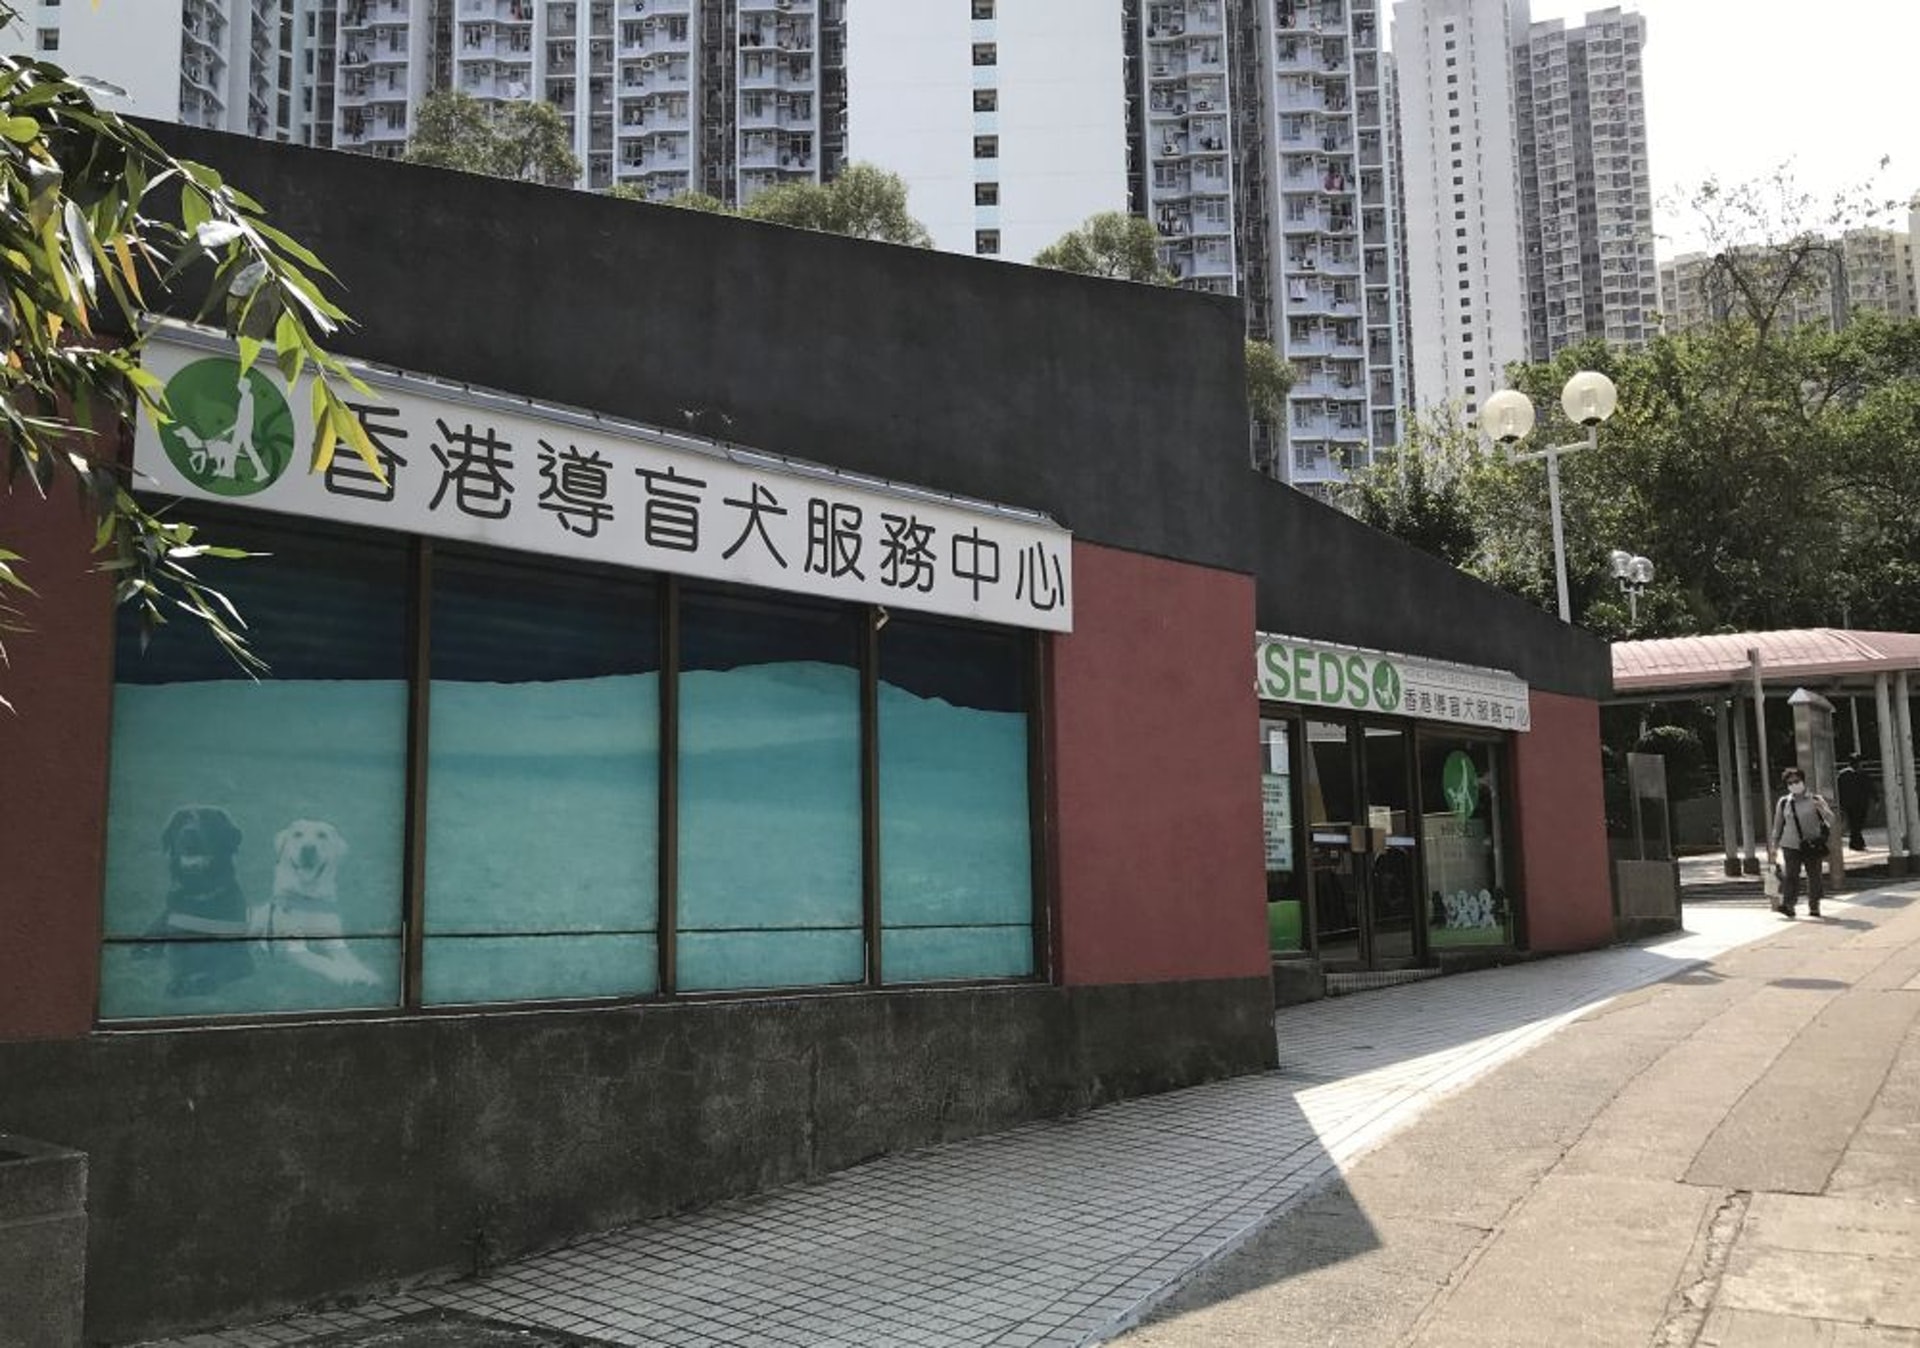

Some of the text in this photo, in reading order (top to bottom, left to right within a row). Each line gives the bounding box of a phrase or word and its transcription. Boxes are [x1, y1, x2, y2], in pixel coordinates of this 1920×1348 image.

[319, 400, 1064, 611] 香港導盲犬服務中心
[1257, 642, 1370, 708] SEDS
